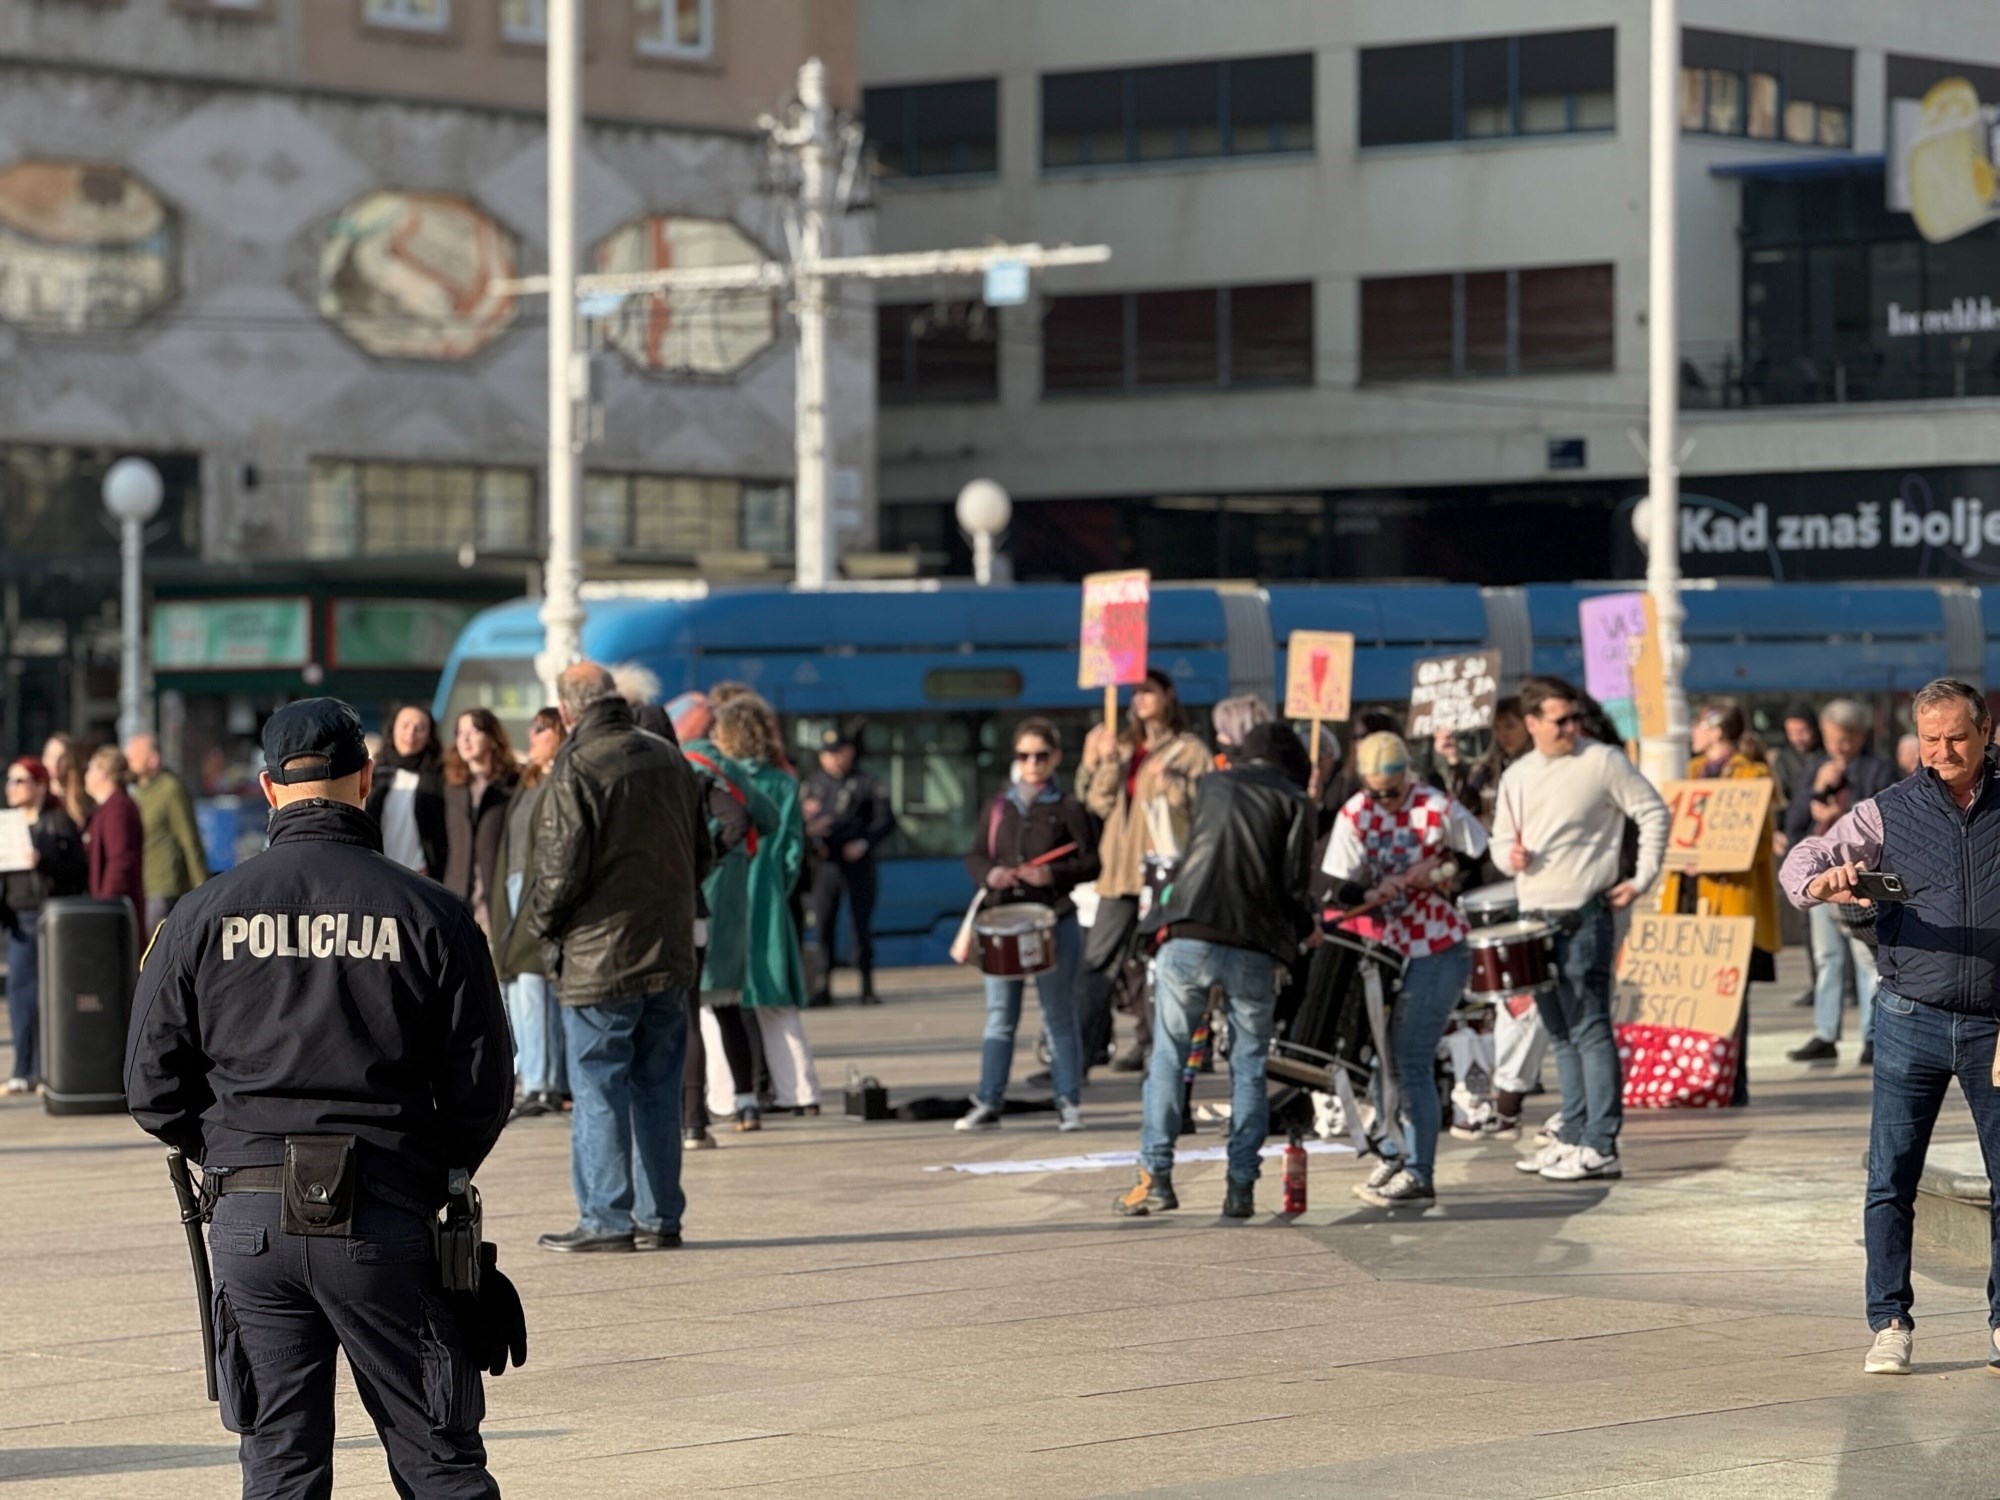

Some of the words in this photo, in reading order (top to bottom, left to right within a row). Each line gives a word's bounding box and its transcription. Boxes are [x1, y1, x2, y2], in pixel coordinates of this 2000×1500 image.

[1680, 502, 1768, 552] Kad
[1776, 501, 1880, 549] znaš
[1890, 497, 2000, 558] bolje
[222, 913, 400, 962] POLICIJA
[1628, 920, 1736, 960] UBIJENIH
[1622, 954, 1681, 987] ŽENA
[1689, 963, 1708, 990] U
